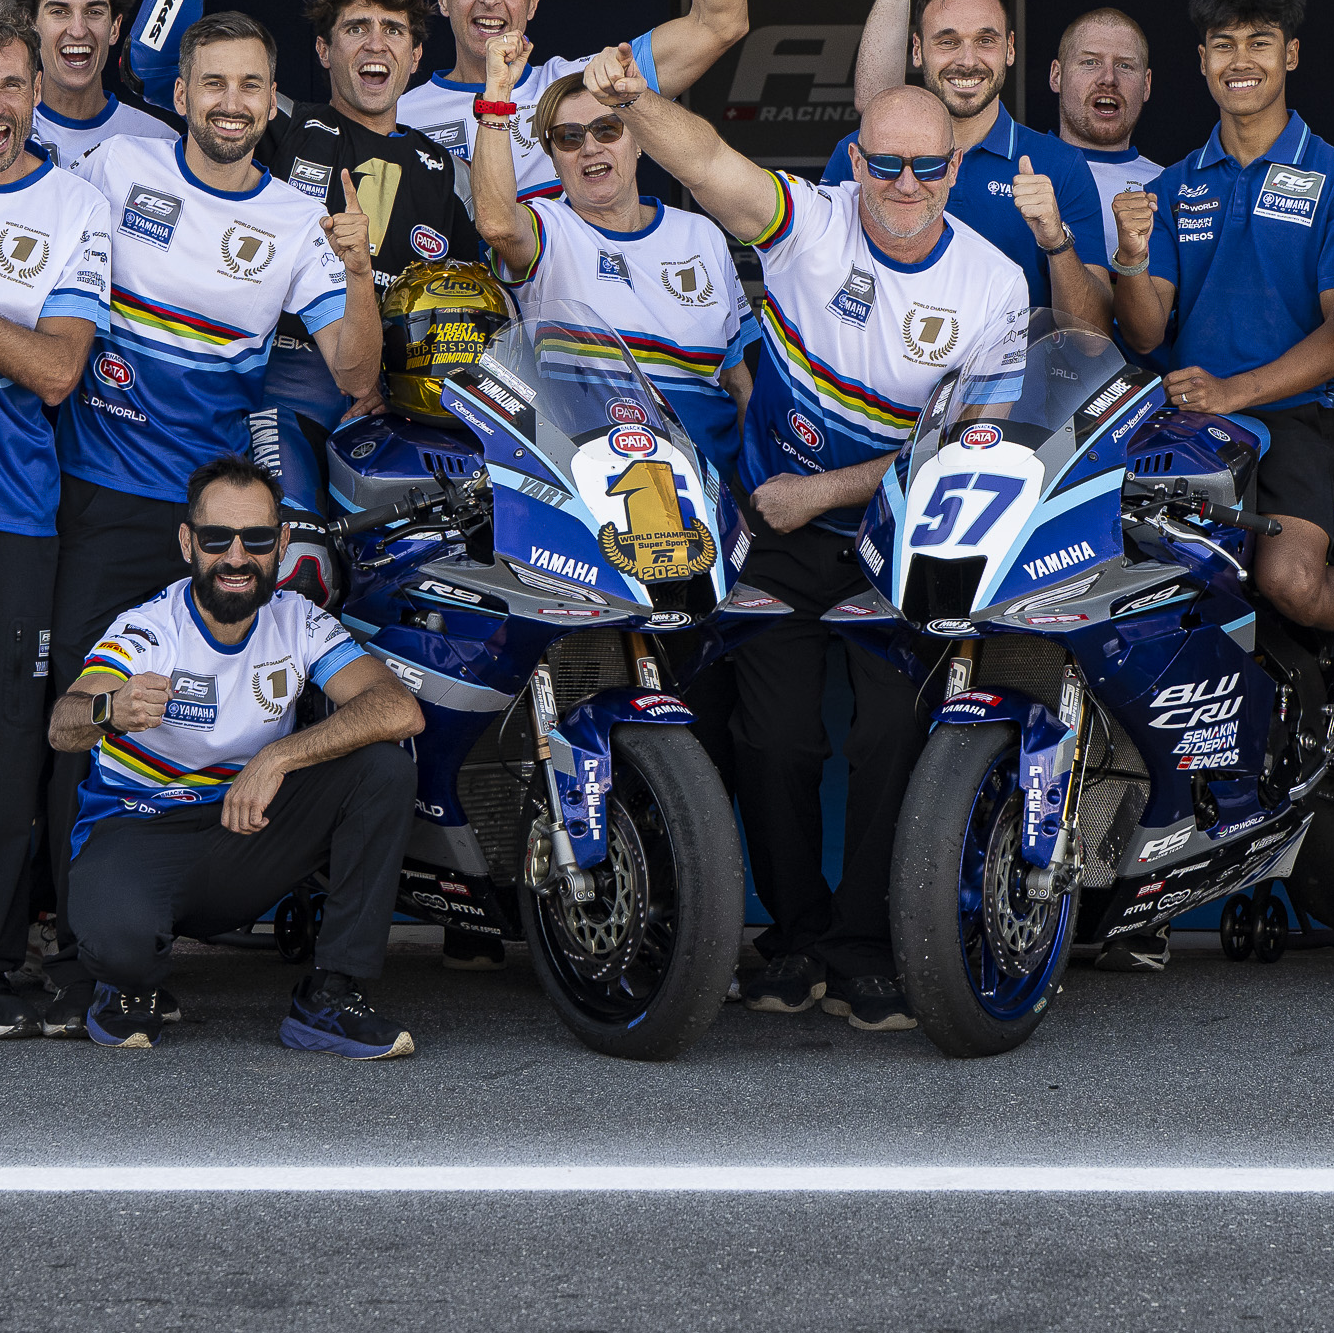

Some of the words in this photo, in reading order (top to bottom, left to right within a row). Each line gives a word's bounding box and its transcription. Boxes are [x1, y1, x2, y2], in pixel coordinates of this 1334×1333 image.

[297, 181, 326, 195] YAMAHA
[1272, 171, 1318, 189] AS
[134, 193, 178, 215] AS
[1190, 201, 1219, 212] WORLD
[1264, 204, 1307, 215] RACING
[1274, 195, 1311, 212] YAMAHA
[134, 215, 170, 239] YAMAHA
[233, 219, 252, 230] WORLD
[251, 226, 277, 239] CHAMPION
[1179, 231, 1214, 243] ENEOS
[10, 235, 39, 263] 1
[235, 236, 264, 263] 1
[416, 235, 438, 252] PATA
[430, 276, 480, 292] Arai
[674, 266, 697, 293] 1
[427, 322, 476, 335] ALBERT
[434, 332, 486, 343] ARENAS
[917, 315, 946, 345] 1
[431, 352, 474, 365] CHAMPION
[476, 376, 525, 416] YAMALUBE
[1083, 377, 1133, 419] YAMALUBE
[91, 397, 105, 409] DP
[106, 404, 147, 423] WORLD
[618, 435, 650, 449] PATA
[967, 431, 995, 444] PATA
[517, 476, 576, 510] YART
[909, 471, 1028, 548] 57
[619, 532, 653, 544] WORLD
[654, 531, 699, 541] CHAMPION
[637, 540, 664, 550] Super
[665, 539, 689, 549] Sport
[729, 530, 752, 573] YAMAHA
[858, 535, 886, 577] YAMAHA
[1023, 540, 1097, 581] YAMAHA
[529, 545, 599, 586] YAMAHA
[641, 564, 690, 581] 2026
[174, 677, 210, 694] AS
[266, 668, 290, 698] 1
[1149, 672, 1241, 708] BLU
[179, 704, 215, 719] YAMAHA
[646, 704, 694, 717] YAMAHA
[941, 703, 987, 717] YAMAHA
[1148, 695, 1244, 729] CRU
[1192, 734, 1237, 754] DEPAN
[1189, 748, 1240, 770] ENEOS
[583, 759, 602, 841] PIRELLI
[1027, 765, 1041, 847] PIRELLI
[1239, 815, 1265, 830] WORLD
[1138, 824, 1195, 859] AS
[450, 902, 485, 917] RTM
[1123, 901, 1154, 917] RTM
